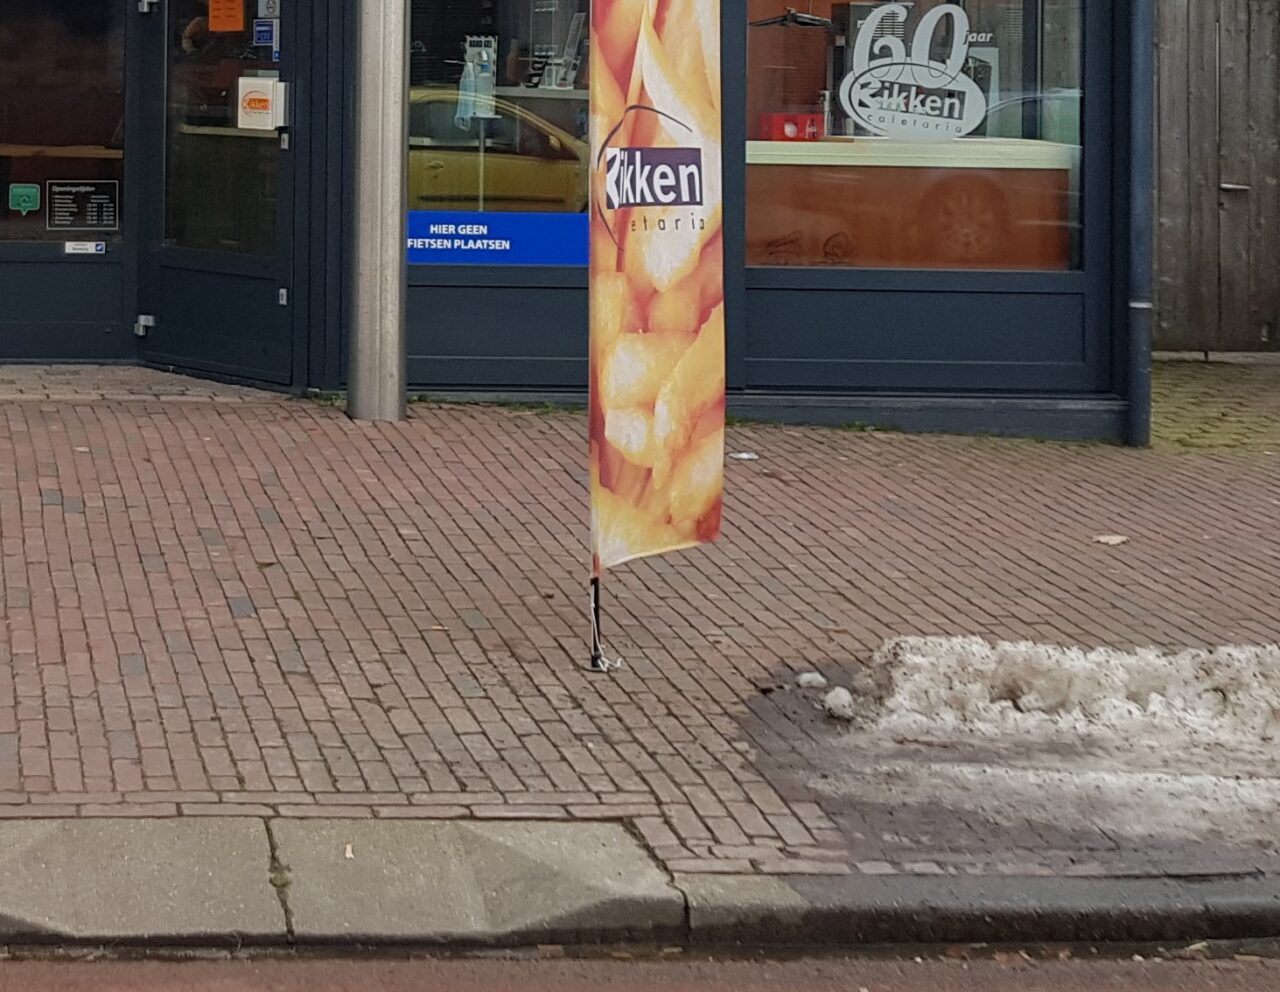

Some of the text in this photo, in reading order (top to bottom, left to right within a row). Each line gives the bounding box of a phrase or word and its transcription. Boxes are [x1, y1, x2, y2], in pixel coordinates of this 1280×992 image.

[853, 4, 969, 88] 60
[963, 31, 993, 45] jaar
[856, 80, 961, 119] Rikken
[605, 148, 701, 209] Rikken
[430, 224, 488, 235] HIER GEEN
[631, 212, 705, 232] etaria
[407, 238, 511, 250] FIETSEN PLAATSEN
